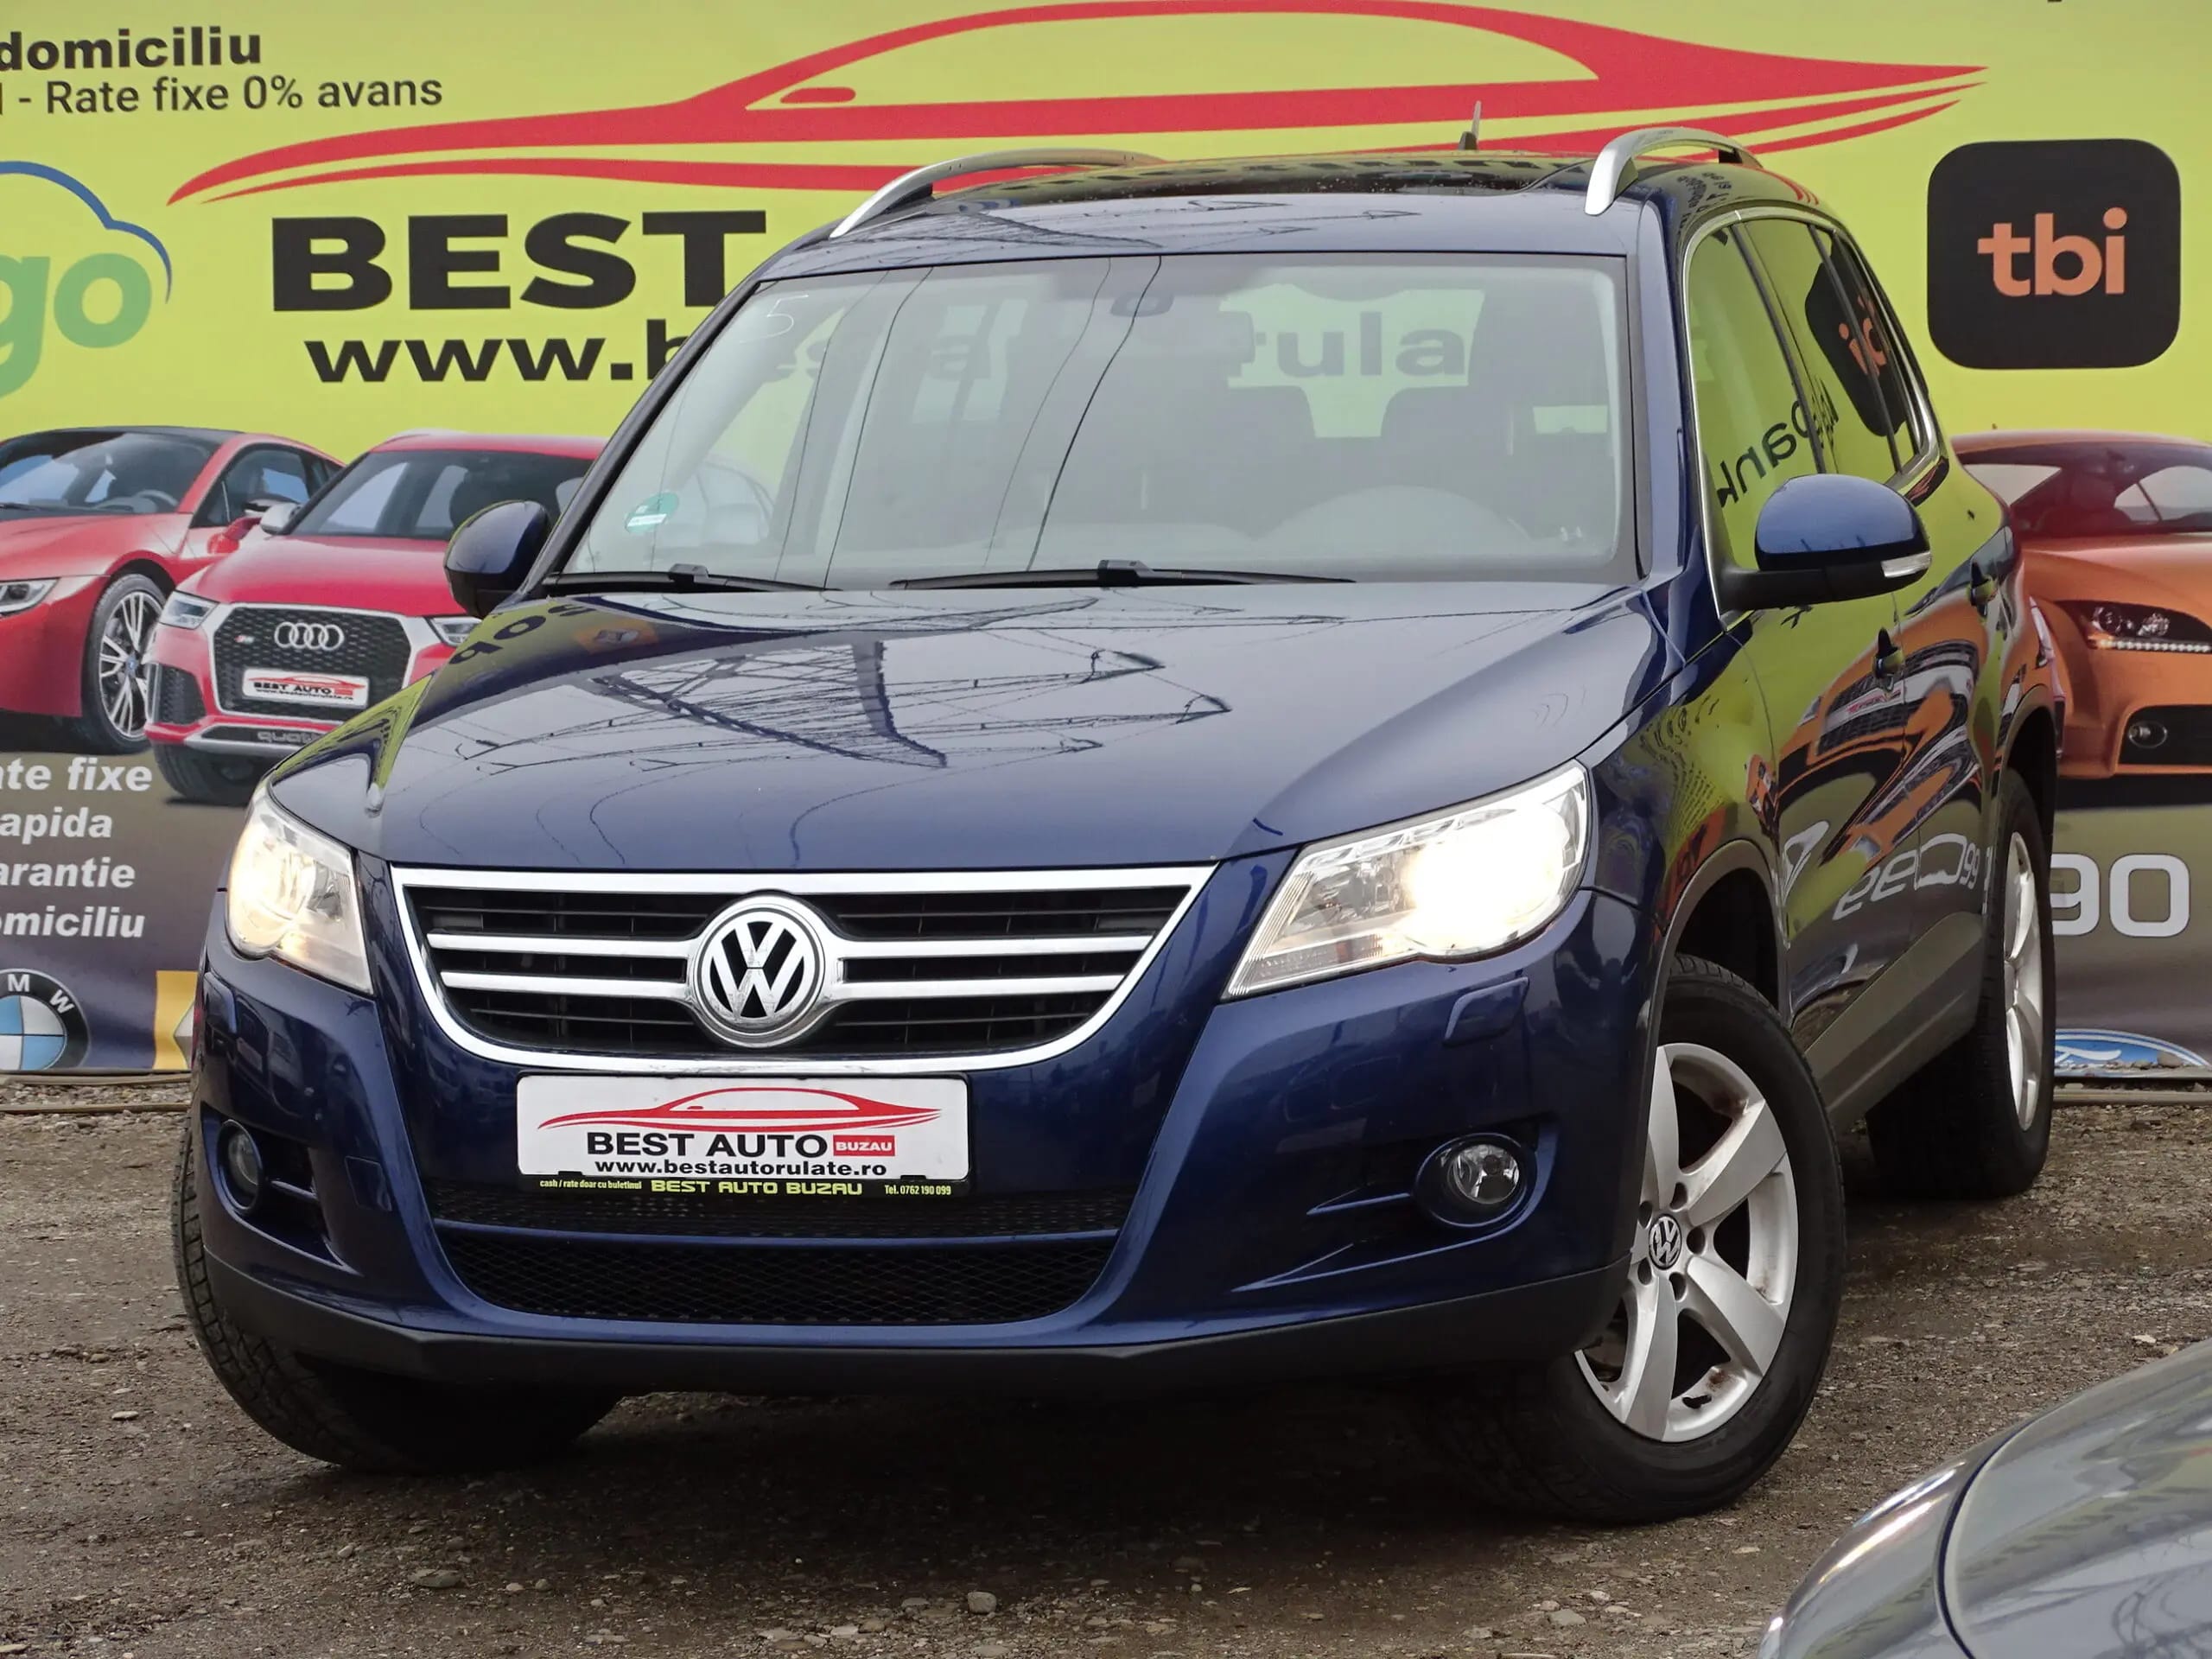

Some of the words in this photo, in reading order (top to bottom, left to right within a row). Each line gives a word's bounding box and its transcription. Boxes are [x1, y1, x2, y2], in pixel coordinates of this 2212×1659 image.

[0, 26, 261, 71] domiciliu
[47, 80, 139, 113] Rate
[153, 75, 229, 111] fixe
[244, 74, 303, 110] 0%
[317, 79, 442, 108] avans
[272, 211, 766, 312] BEST
[1977, 207, 2128, 296] tbi
[294, 684, 332, 695] AUTO
[67, 757, 152, 791] fixe
[587, 1132, 695, 1157] BEST
[705, 1134, 828, 1159] AUTO
[836, 1141, 893, 1152] BUZAU
[594, 1159, 887, 1177] www.bestautorulate.ro
[539, 1179, 558, 1187] cash
[580, 1179, 596, 1188] doar
[651, 1179, 710, 1192] BEST
[718, 1180, 779, 1194] AUTO
[786, 1181, 862, 1195] BUZAU
[884, 1184, 899, 1194] Tel.
[899, 1185, 920, 1195] 0762
[920, 1185, 935, 1195] 190
[936, 1185, 951, 1196] 099
